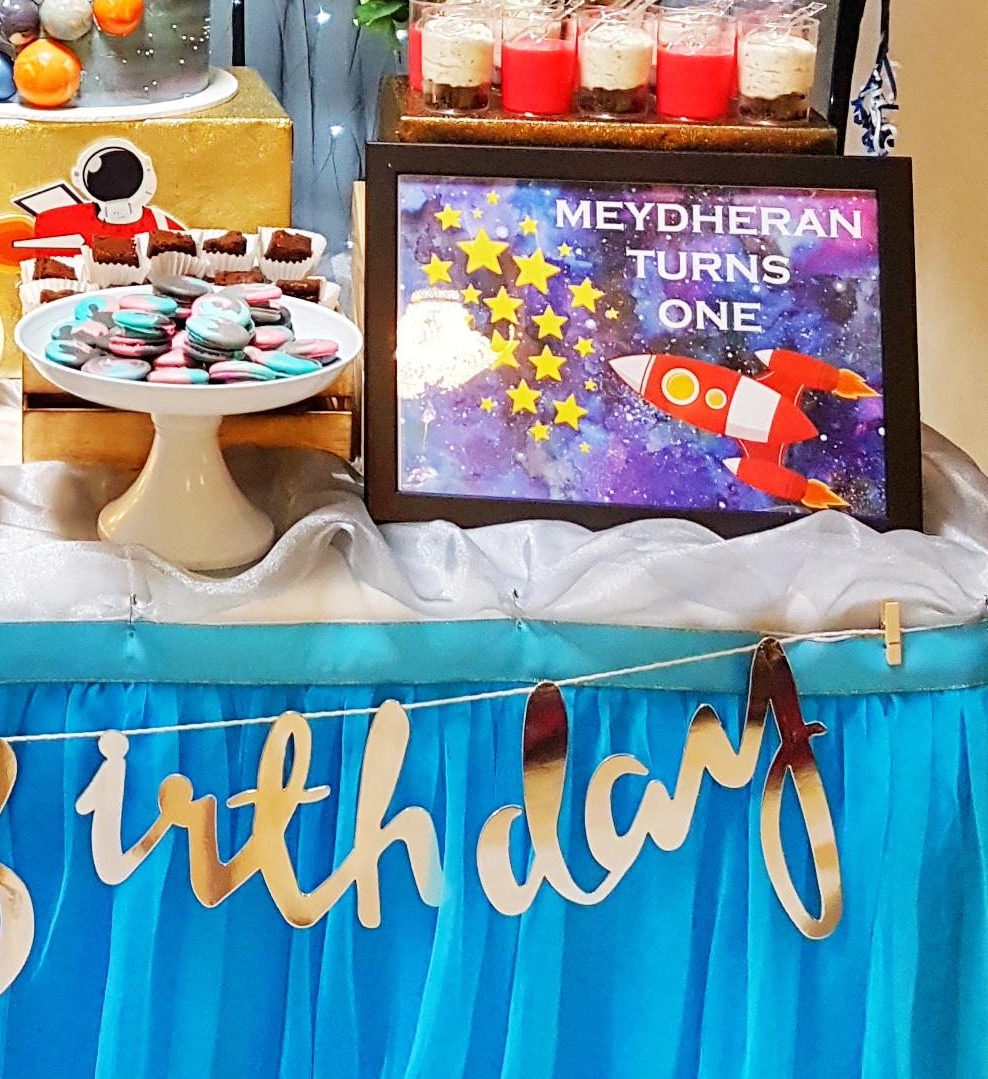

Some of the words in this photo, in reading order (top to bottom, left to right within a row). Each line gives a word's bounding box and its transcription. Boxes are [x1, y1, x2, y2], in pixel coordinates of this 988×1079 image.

[555, 199, 862, 239] MEYDHERAN
[626, 247, 791, 285] TURNS
[658, 298, 762, 332] ONE
